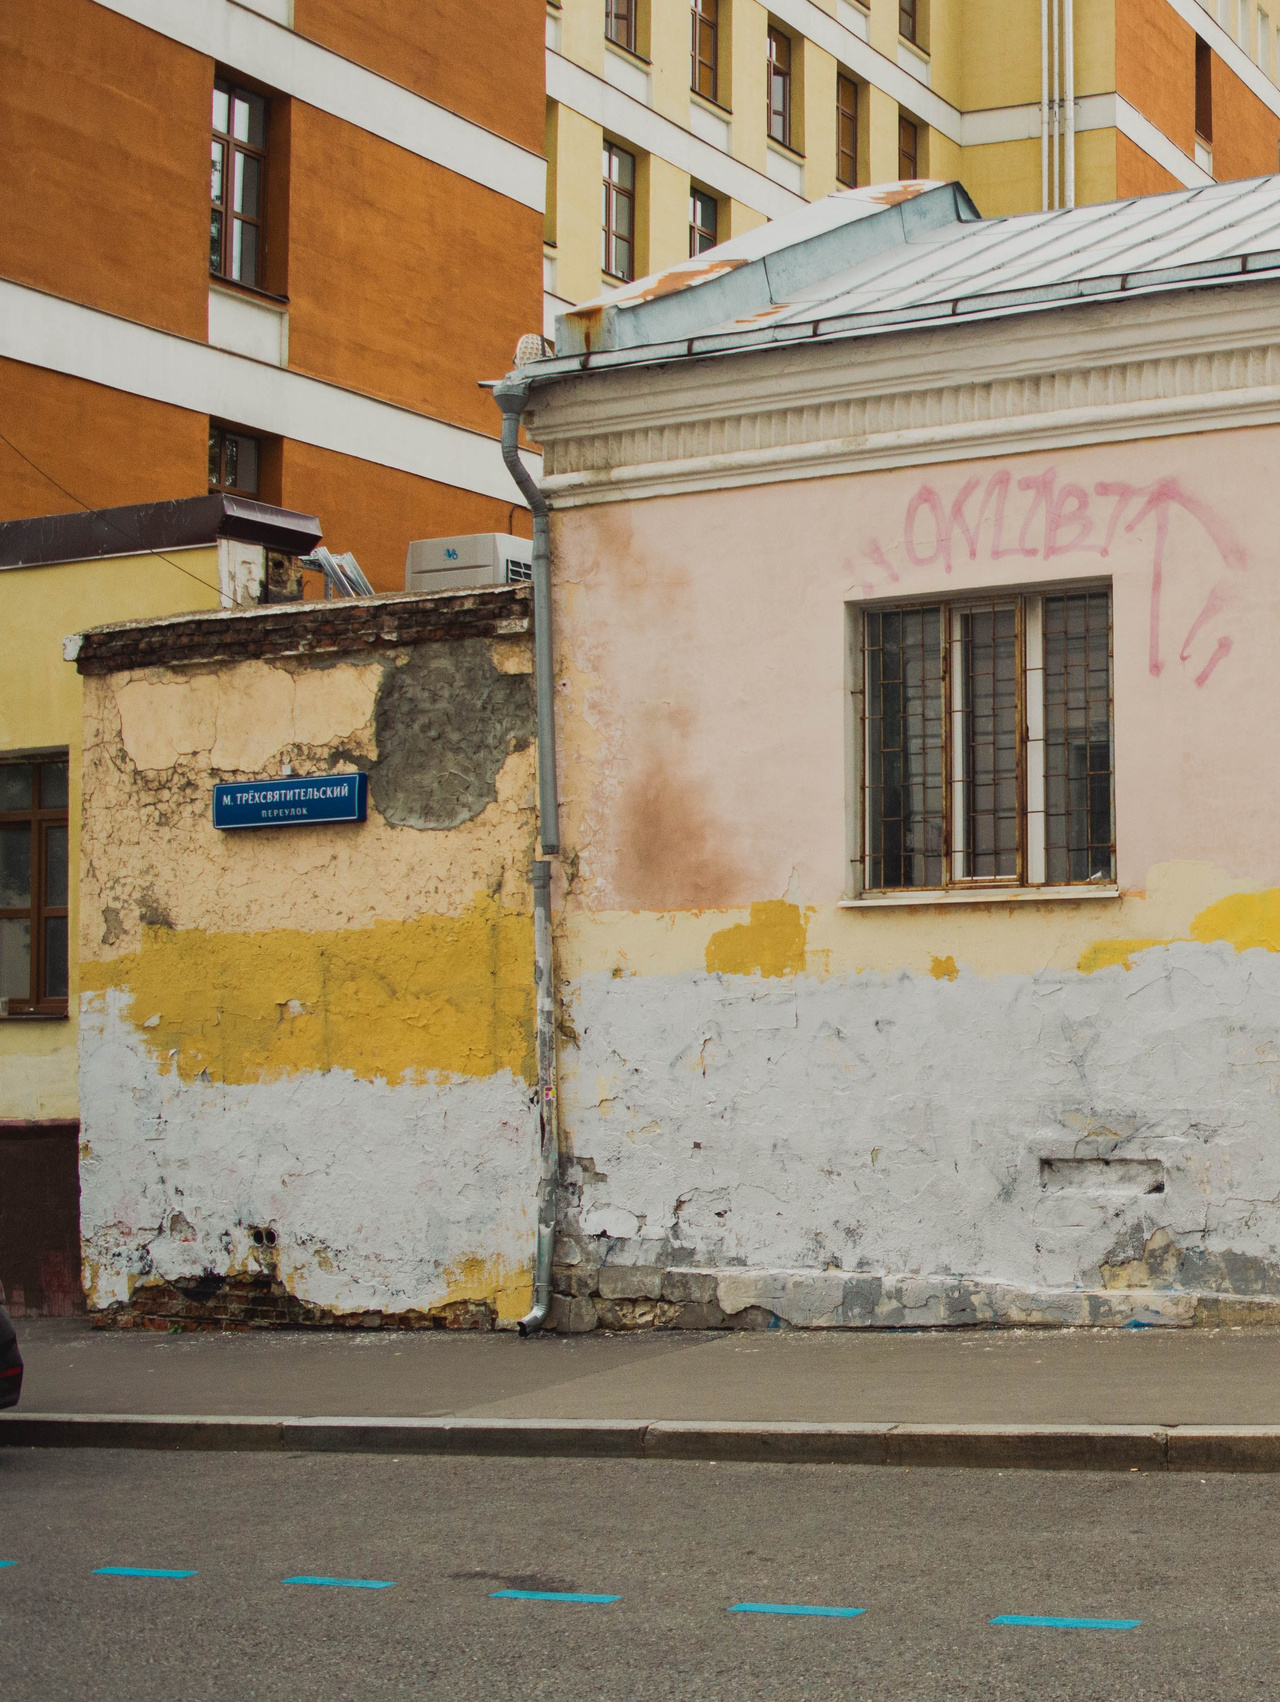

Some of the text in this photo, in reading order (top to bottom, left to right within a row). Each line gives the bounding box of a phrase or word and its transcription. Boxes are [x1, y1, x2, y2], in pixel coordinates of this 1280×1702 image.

[222, 783, 349, 806] М. ТРЁХСВЯТИТЕЛЬСКИЙ
[261, 807, 309, 818] ПЕРЕУЛОК
